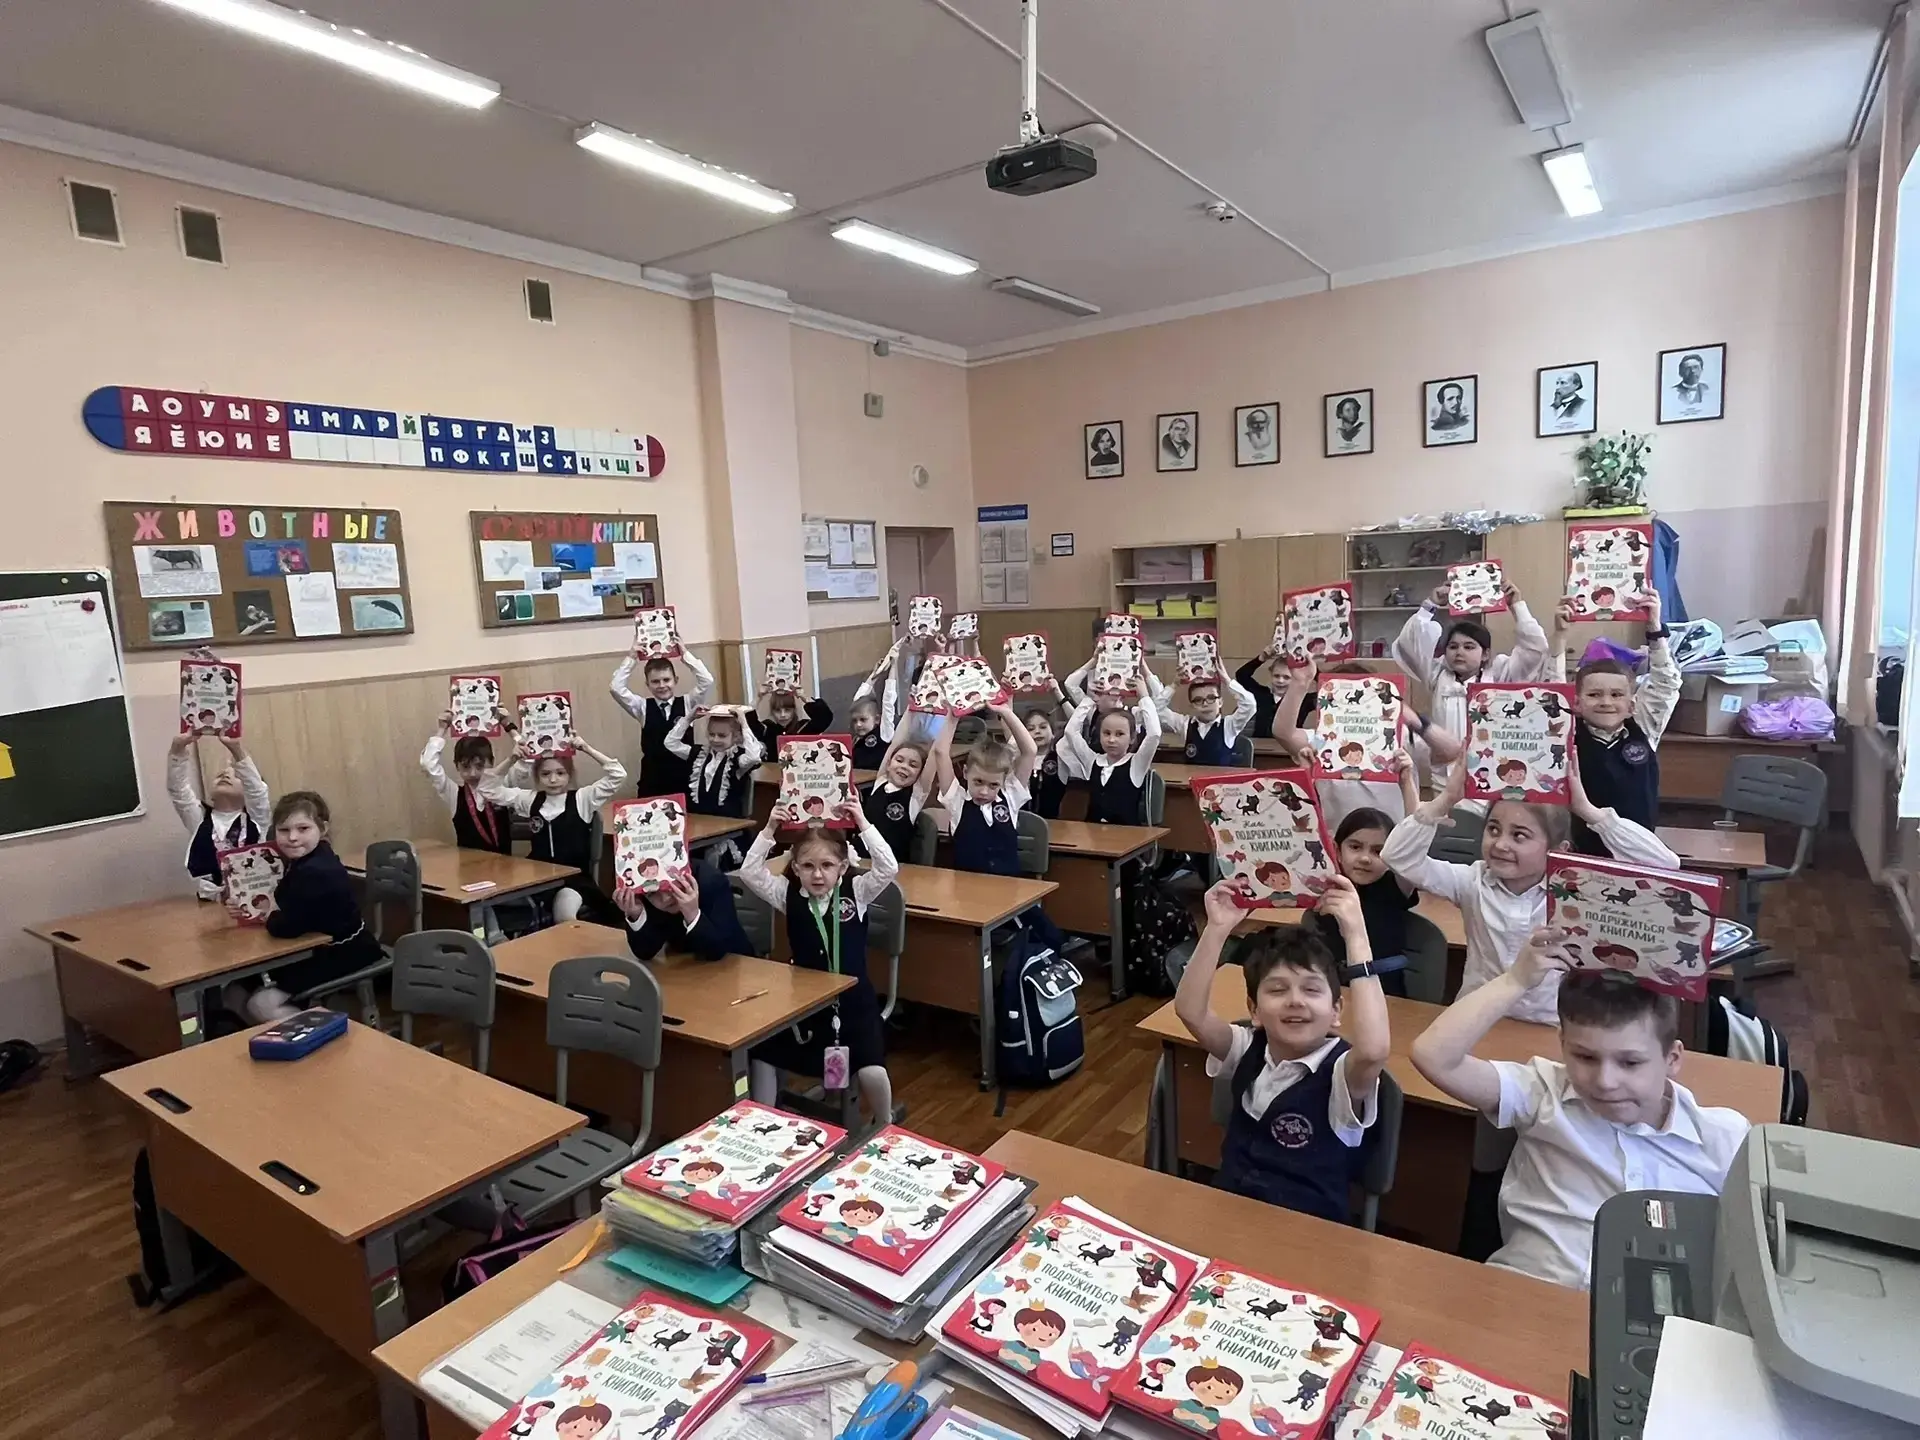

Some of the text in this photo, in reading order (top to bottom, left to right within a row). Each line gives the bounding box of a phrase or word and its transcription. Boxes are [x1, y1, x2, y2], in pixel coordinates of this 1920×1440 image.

[133, 509, 387, 541] ЖИВОТНЫЕ
[592, 521, 646, 543] КНИГИ
[1585, 910, 1665, 934] ПОДРУЖИТЬСЯ
[1600, 924, 1657, 943] КНИГАМИ
[870, 1168, 933, 1197] ПОДРУЖИТЬСЯ
[870, 1182, 919, 1204] КНИГАМИ
[1063, 1260, 1094, 1278] Как
[1041, 1263, 1119, 1306] ПОДРУЖИТЬСЯ
[1044, 1281, 1102, 1315] КНИГАМИ
[1232, 1316, 1269, 1333] Как
[1209, 1320, 1298, 1359] ПОДРУЖИТЬСЯ
[631, 1350, 660, 1366] Как
[1216, 1338, 1281, 1370] КНИГАМИ
[605, 1355, 678, 1390] ПОДРУЖИТЬСЯ
[602, 1374, 656, 1402] КНИГАМИ
